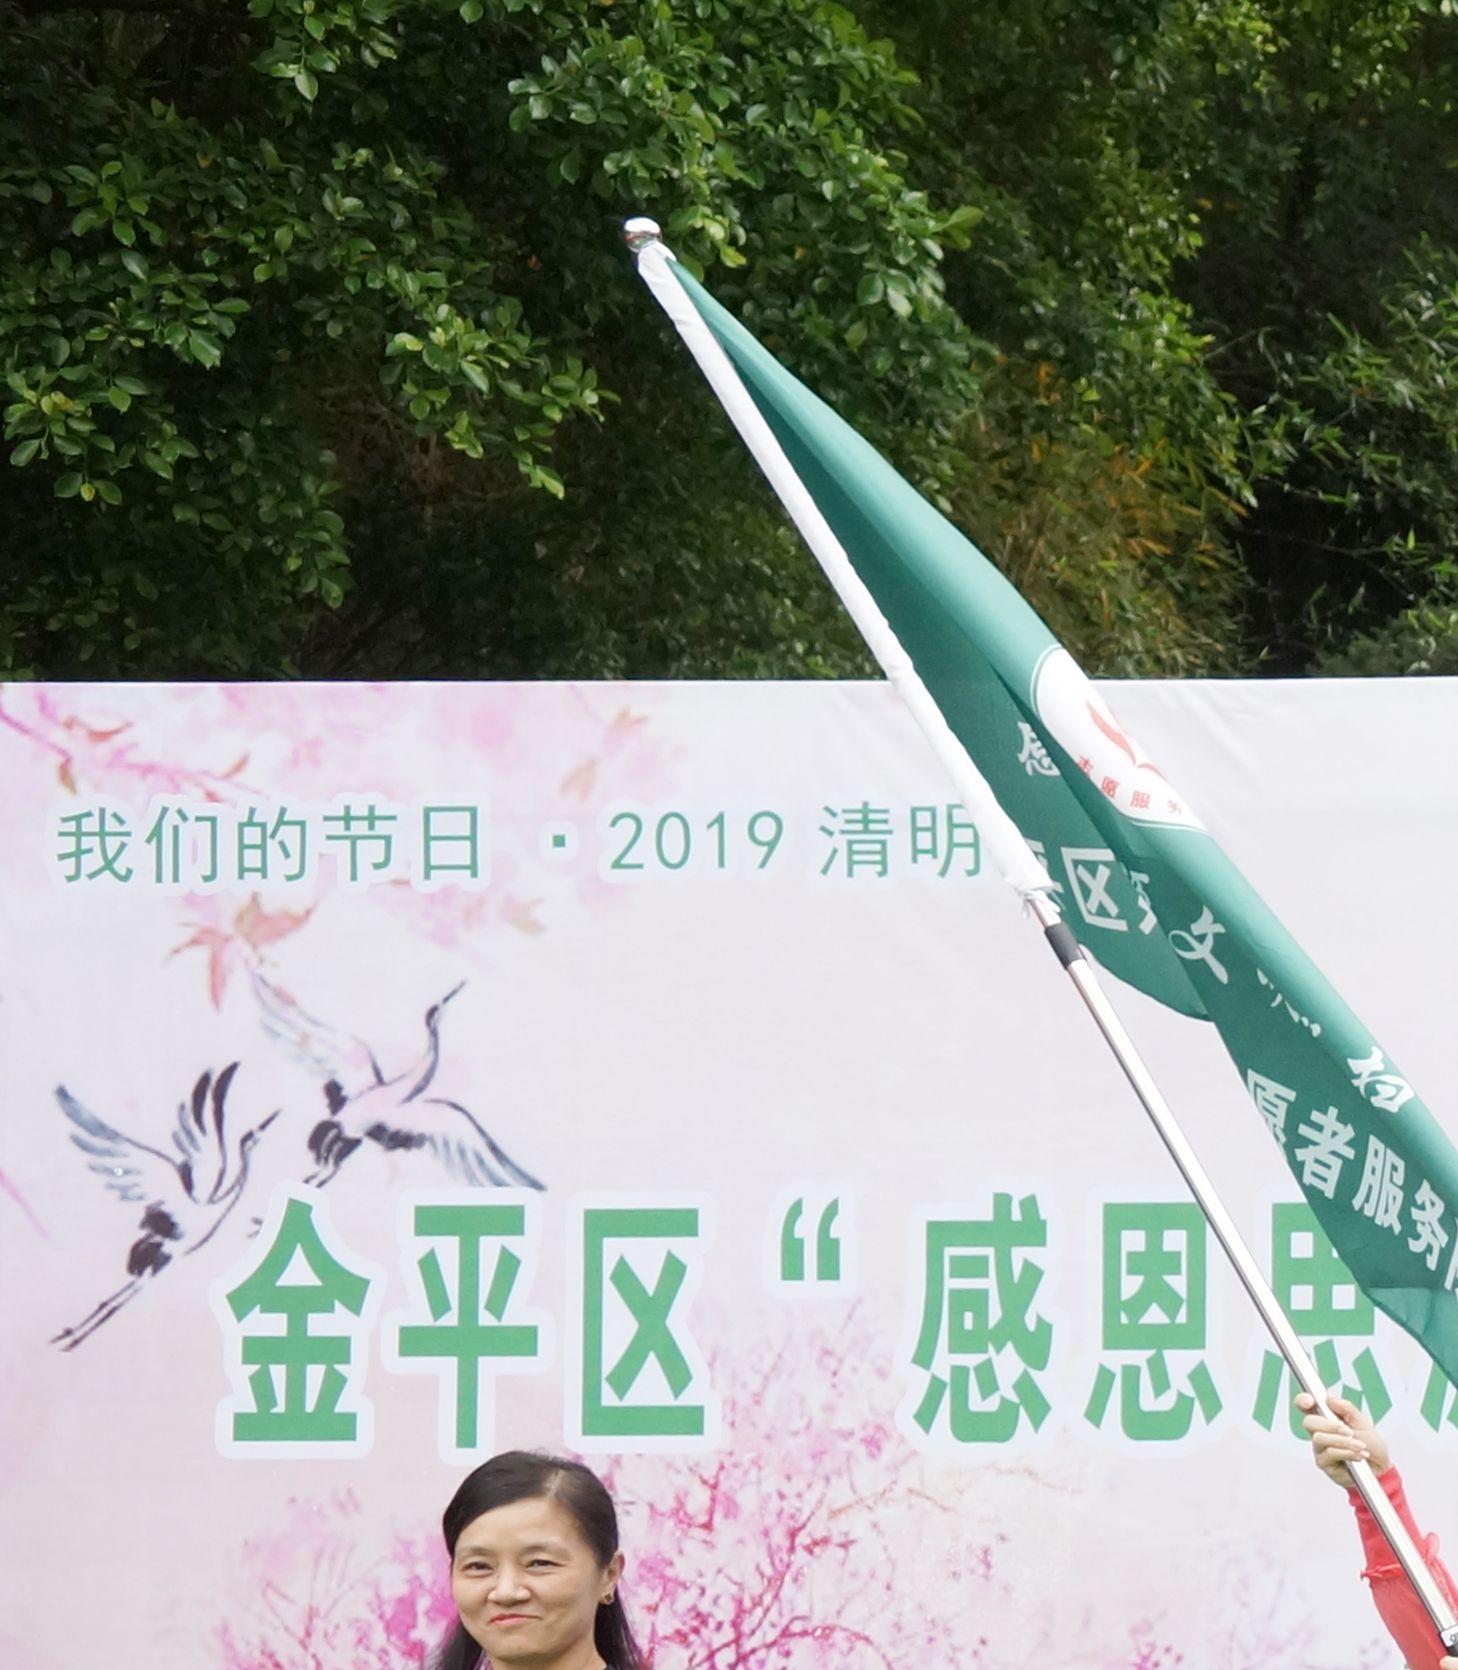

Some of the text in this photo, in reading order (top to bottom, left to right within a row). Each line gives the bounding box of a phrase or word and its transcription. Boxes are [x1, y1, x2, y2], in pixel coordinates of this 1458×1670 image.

[57, 804, 480, 884] 我们的节日
[818, 801, 982, 879] 清明
